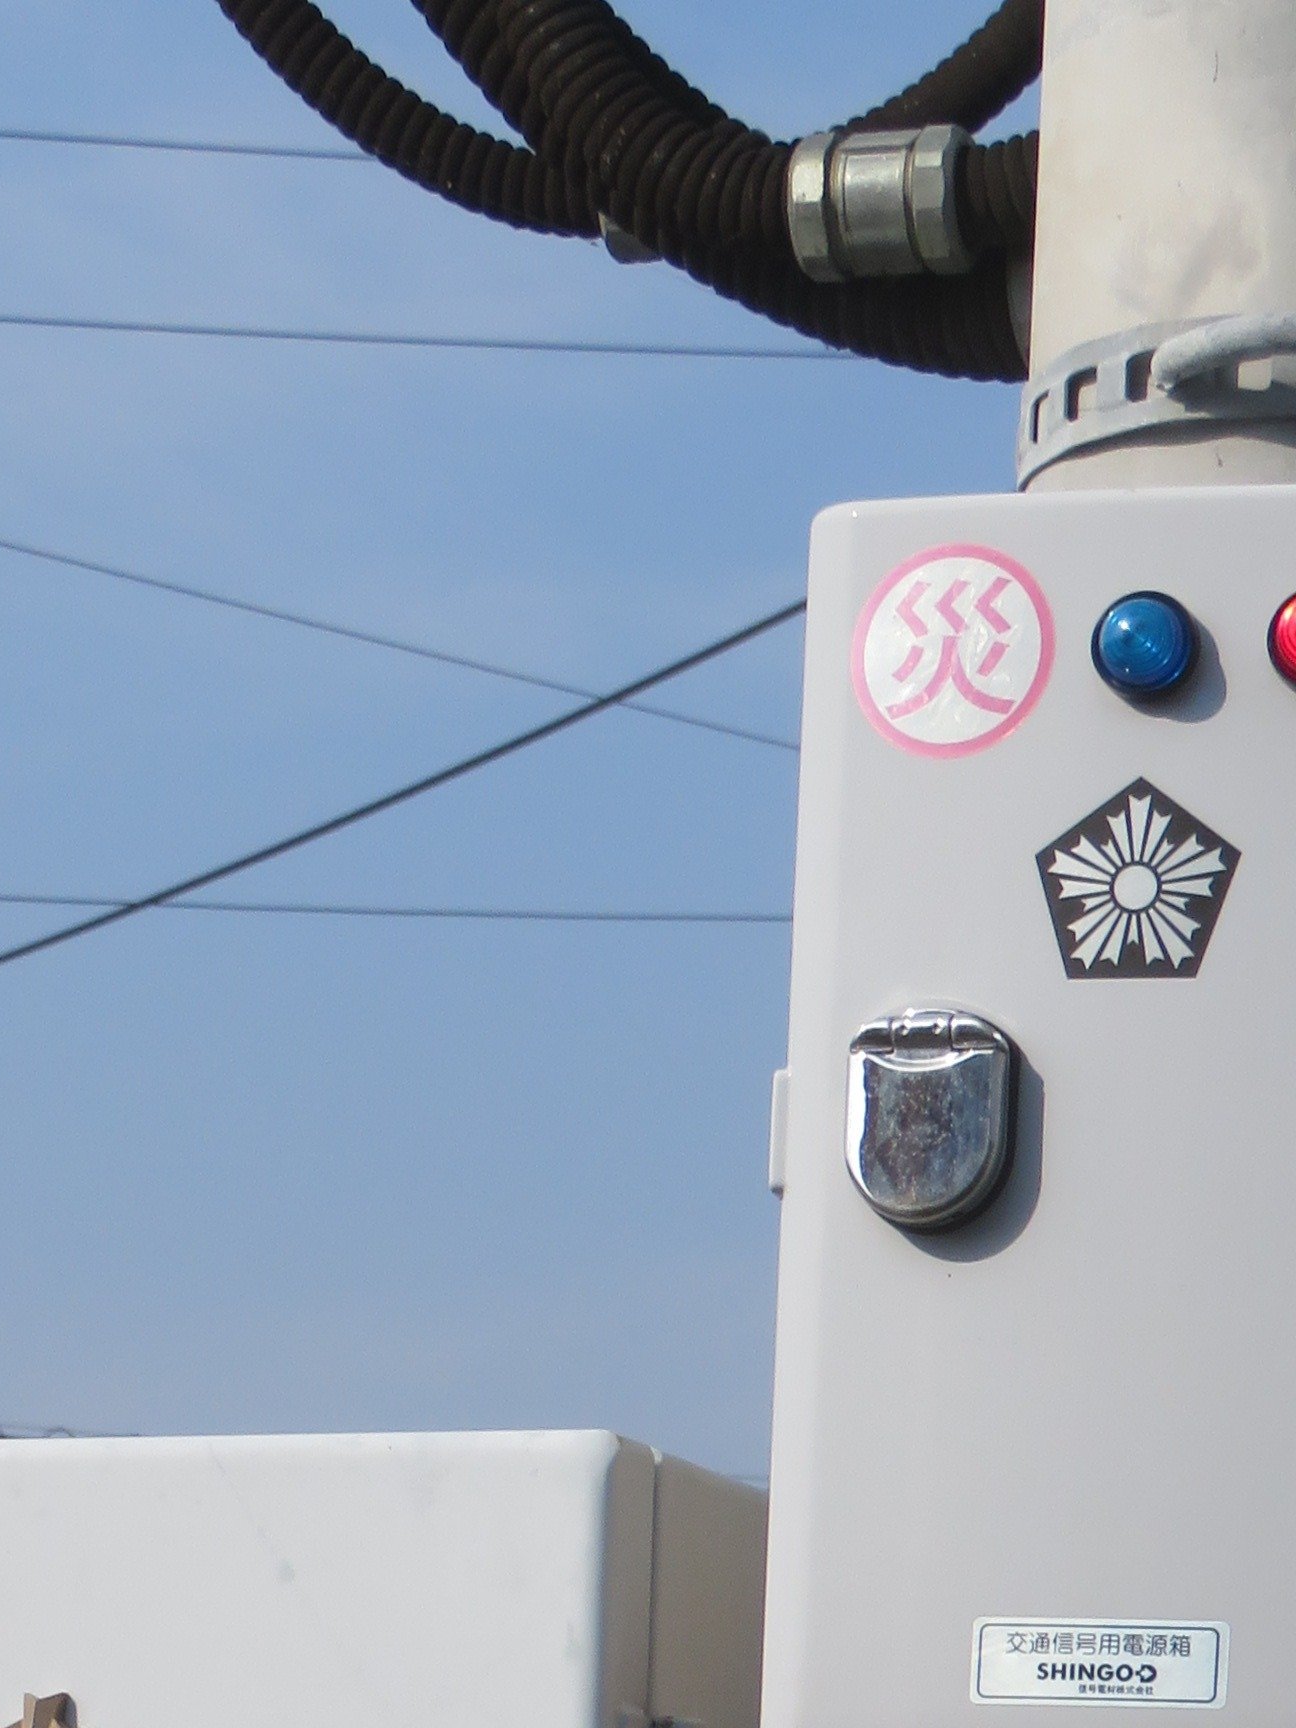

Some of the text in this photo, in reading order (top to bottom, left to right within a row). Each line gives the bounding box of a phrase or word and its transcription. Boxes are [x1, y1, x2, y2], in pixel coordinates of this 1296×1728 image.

[884, 576, 1018, 721] 災
[1005, 1632, 1192, 1657] 交通信号用電源箱
[1036, 1662, 1134, 1683] SHINGO
